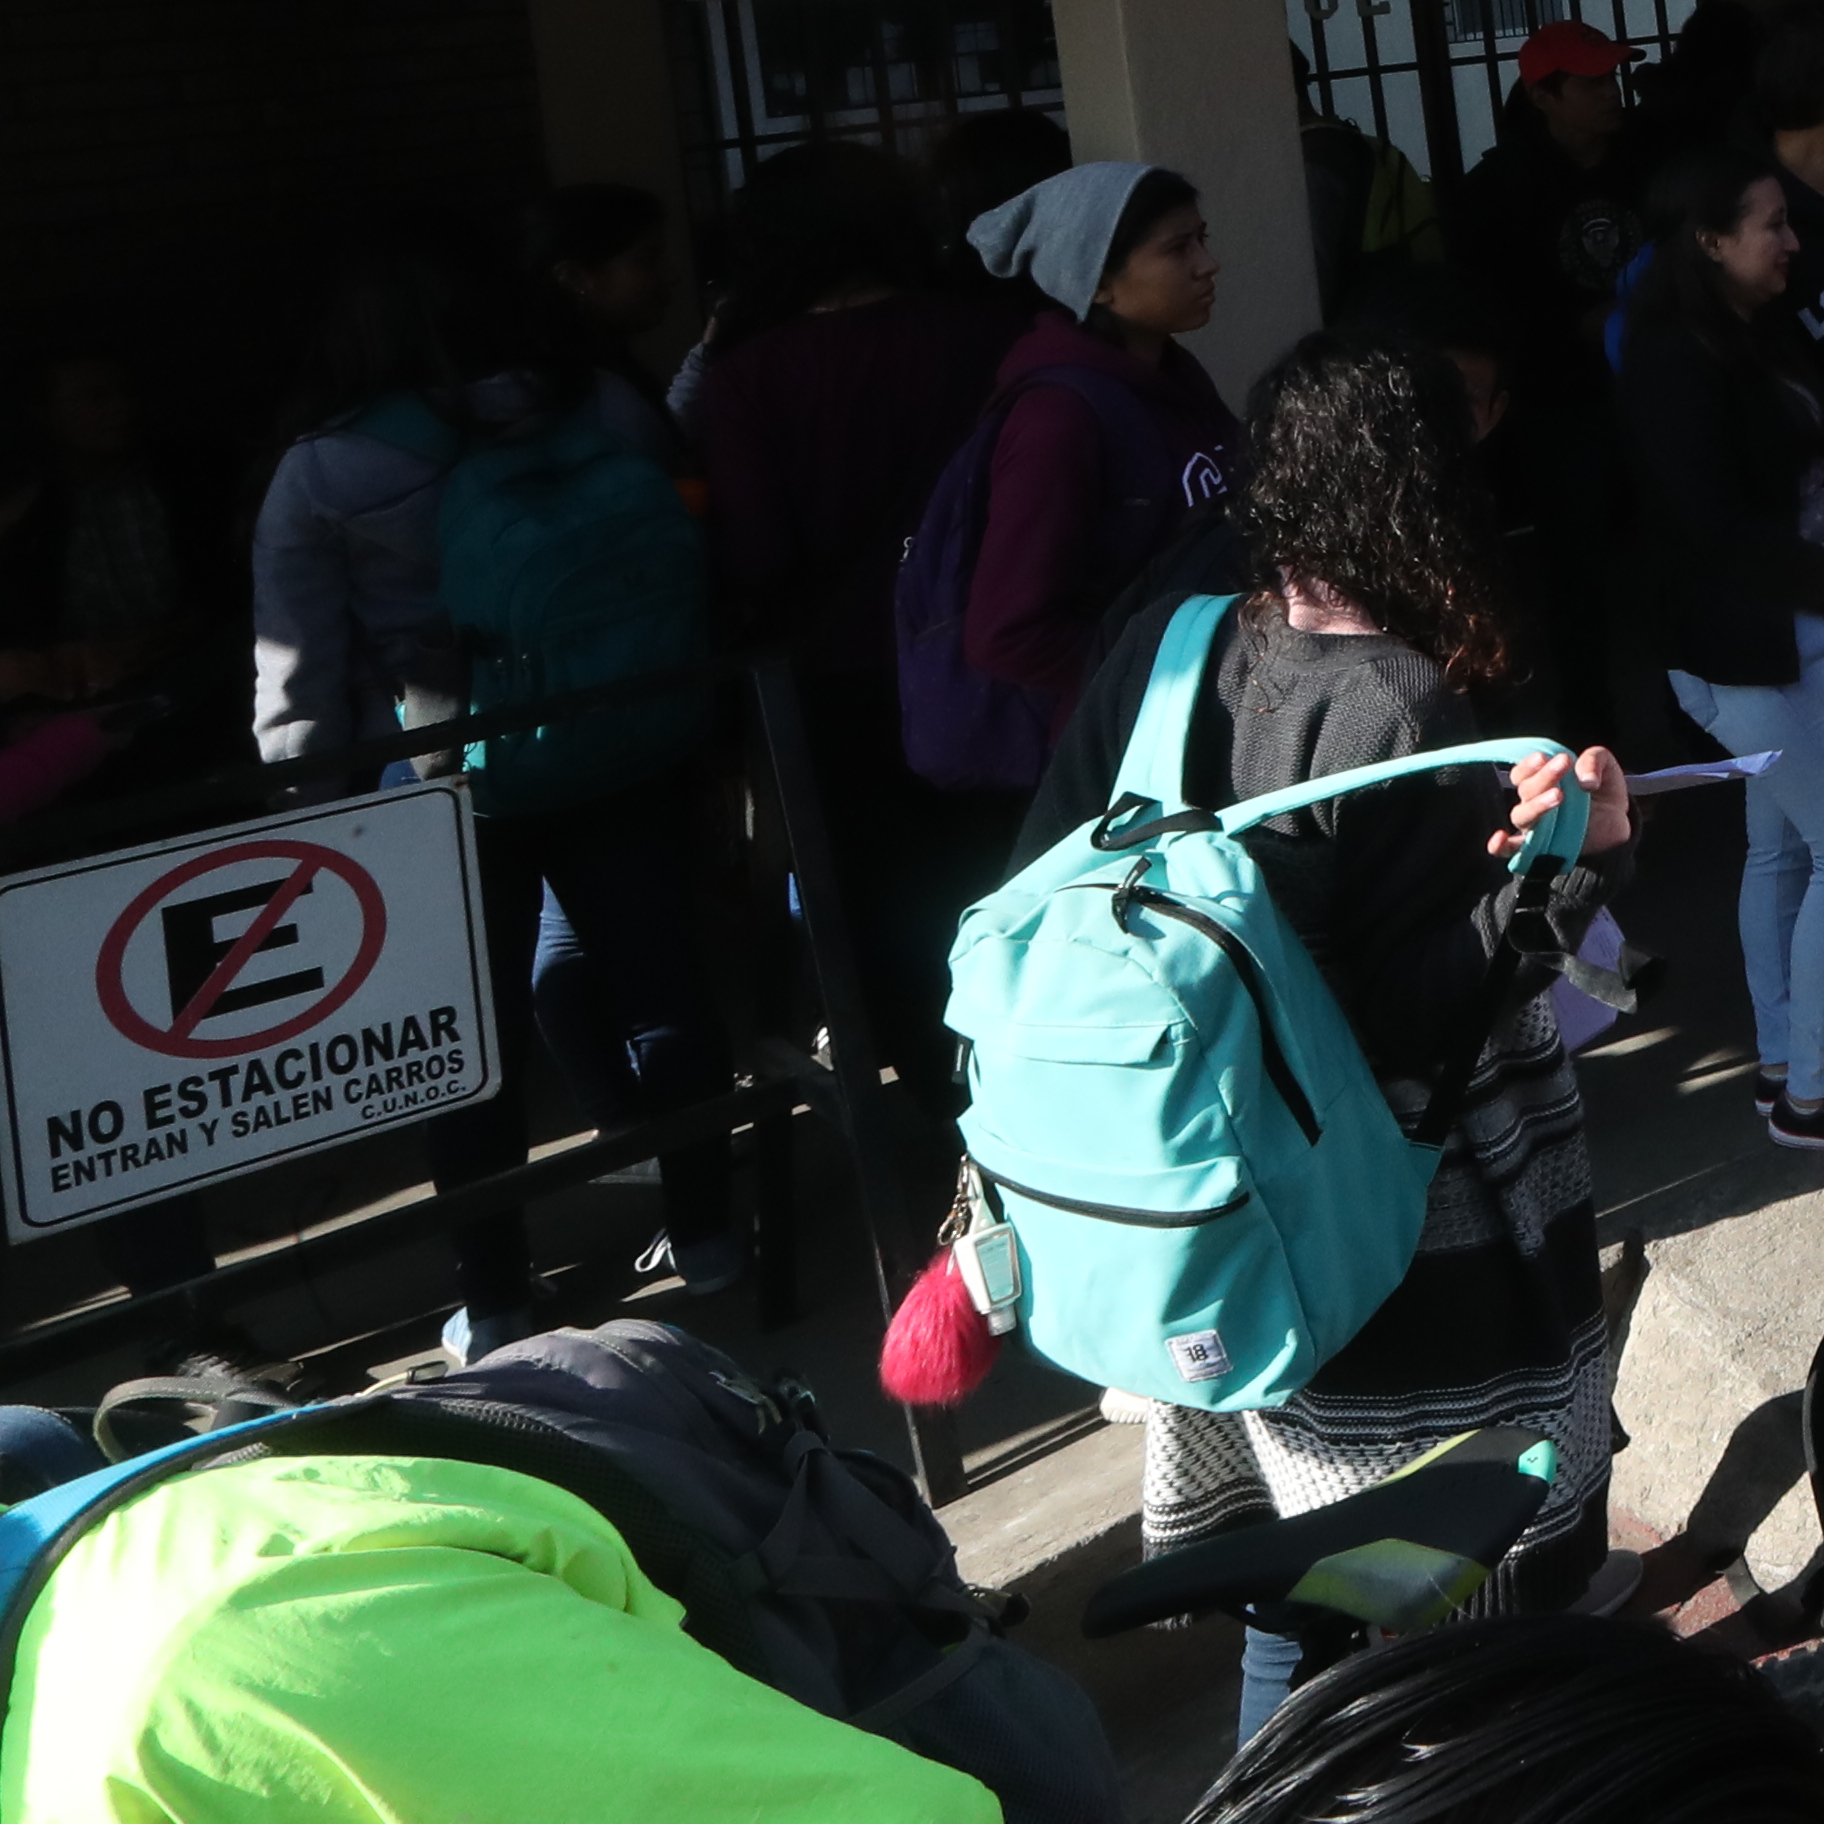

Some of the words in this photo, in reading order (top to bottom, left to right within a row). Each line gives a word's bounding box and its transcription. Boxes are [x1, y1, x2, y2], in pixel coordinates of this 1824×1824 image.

[46, 1100, 124, 1159] NO
[144, 1005, 462, 1131] ESTACIONAR
[50, 1130, 188, 1194] ENTRAN
[199, 1120, 220, 1147] Y
[232, 1087, 333, 1140] SALEN
[344, 1049, 466, 1104] CARROS
[361, 1081, 467, 1121] C.U.N.O.C.
